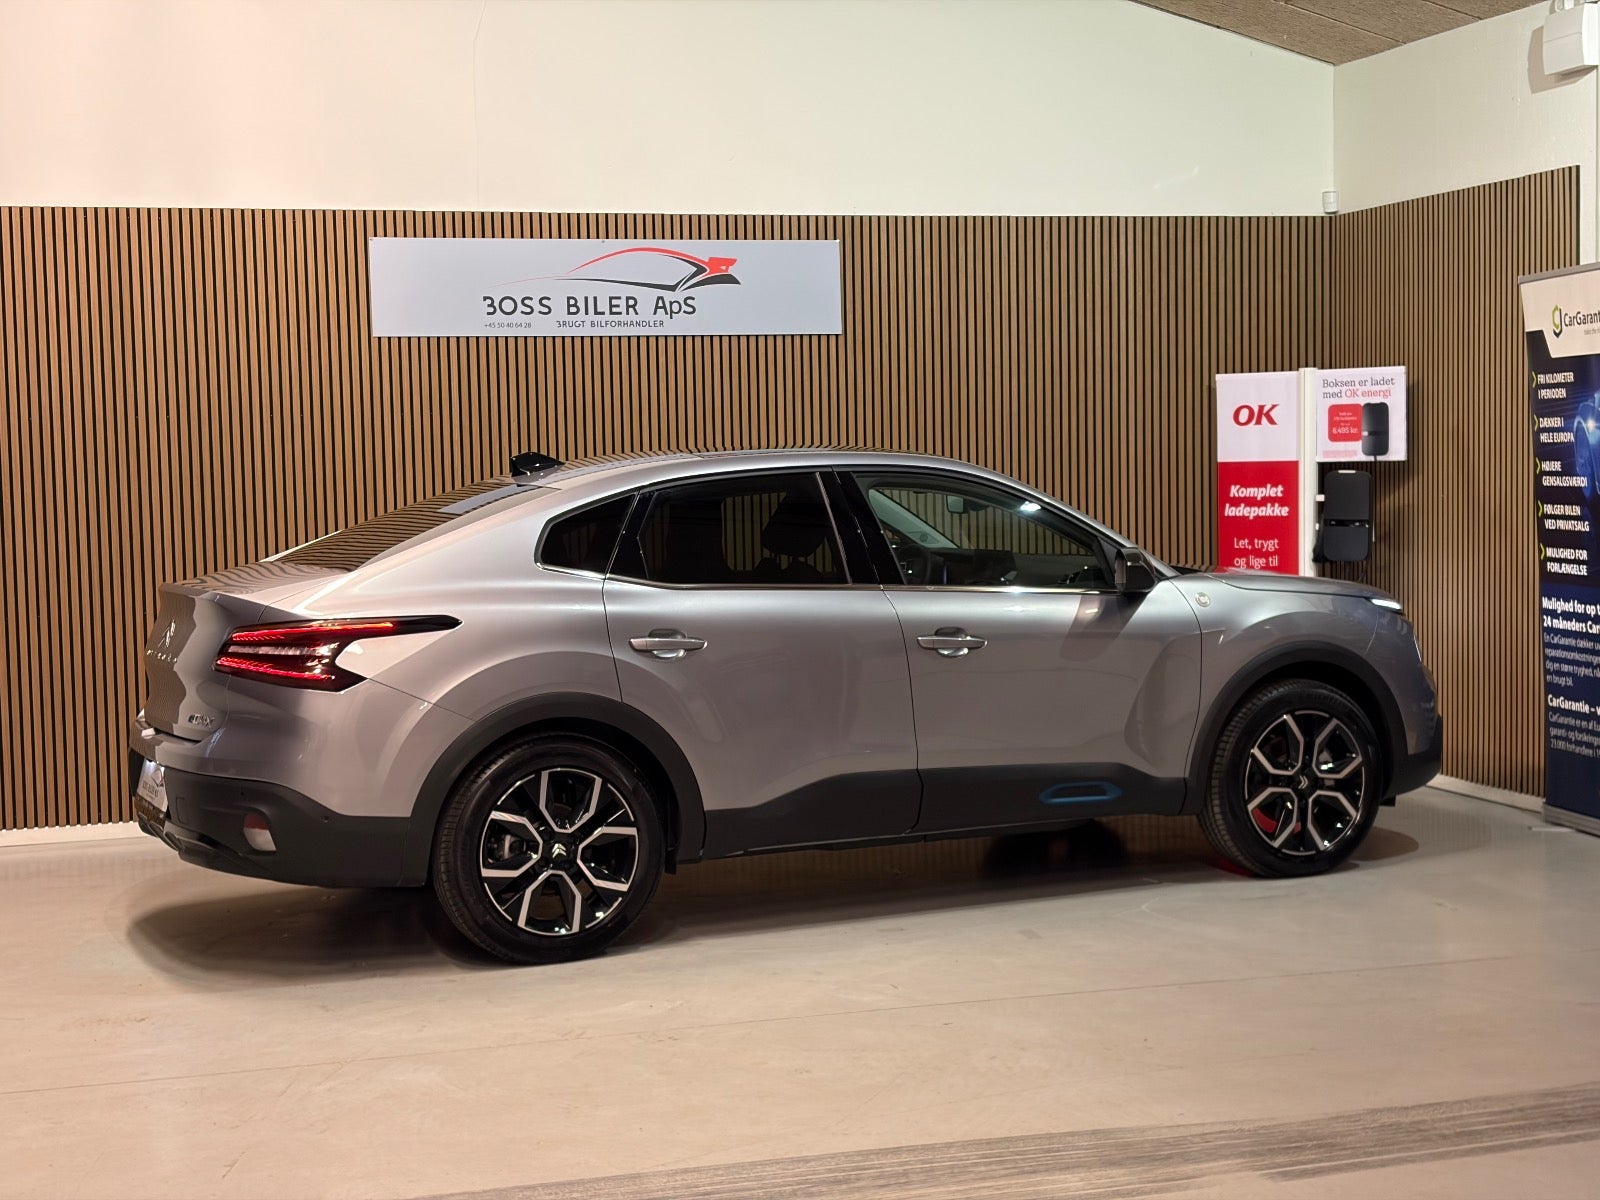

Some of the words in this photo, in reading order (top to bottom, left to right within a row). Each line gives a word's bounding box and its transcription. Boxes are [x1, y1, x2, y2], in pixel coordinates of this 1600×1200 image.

[566, 295, 639, 316] BILER
[652, 295, 697, 320] ApS
[590, 320, 665, 328] BILFORHANDLER
[1322, 378, 1356, 389] Boksen
[1358, 379, 1368, 387] er
[1370, 376, 1396, 386] ladet
[1537, 373, 1546, 384] FRI
[1545, 372, 1575, 384] KILOMETER
[1322, 389, 1343, 399] med
[1344, 388, 1360, 398] OK
[1361, 388, 1392, 400] energi
[1541, 388, 1567, 400] PERIODEN
[1232, 403, 1280, 427] OK
[1539, 417, 1562, 428] DÆKKER
[1540, 432, 1553, 443] HELE
[1553, 431, 1575, 443] EUROPA
[1541, 460, 1562, 472] HØJERE
[1542, 475, 1588, 487] GENSALGSVÆRDI
[1229, 483, 1284, 501] Komplet
[1224, 502, 1290, 520] ladepakke
[1543, 503, 1564, 515] FØLGER
[1564, 504, 1581, 516] BILEN
[1544, 518, 1557, 530] VED
[1556, 519, 1590, 532] PRIVATSALG
[1233, 537, 1252, 550] Let,
[1254, 537, 1280, 552] trygt
[1546, 546, 1575, 560] MULIGHED
[1575, 549, 1588, 561] FOR
[1233, 557, 1247, 569] og
[1249, 554, 1266, 570] lige
[1268, 554, 1279, 567] til
[1546, 561, 1588, 576] FORLÆNGELSE
[1542, 596, 1574, 614] Mulighed
[1574, 599, 1585, 614] for
[1585, 604, 1596, 618] op
[1543, 614, 1552, 628] 24
[1552, 615, 1587, 633] måneders
[1547, 693, 1590, 714] CarGarantie
